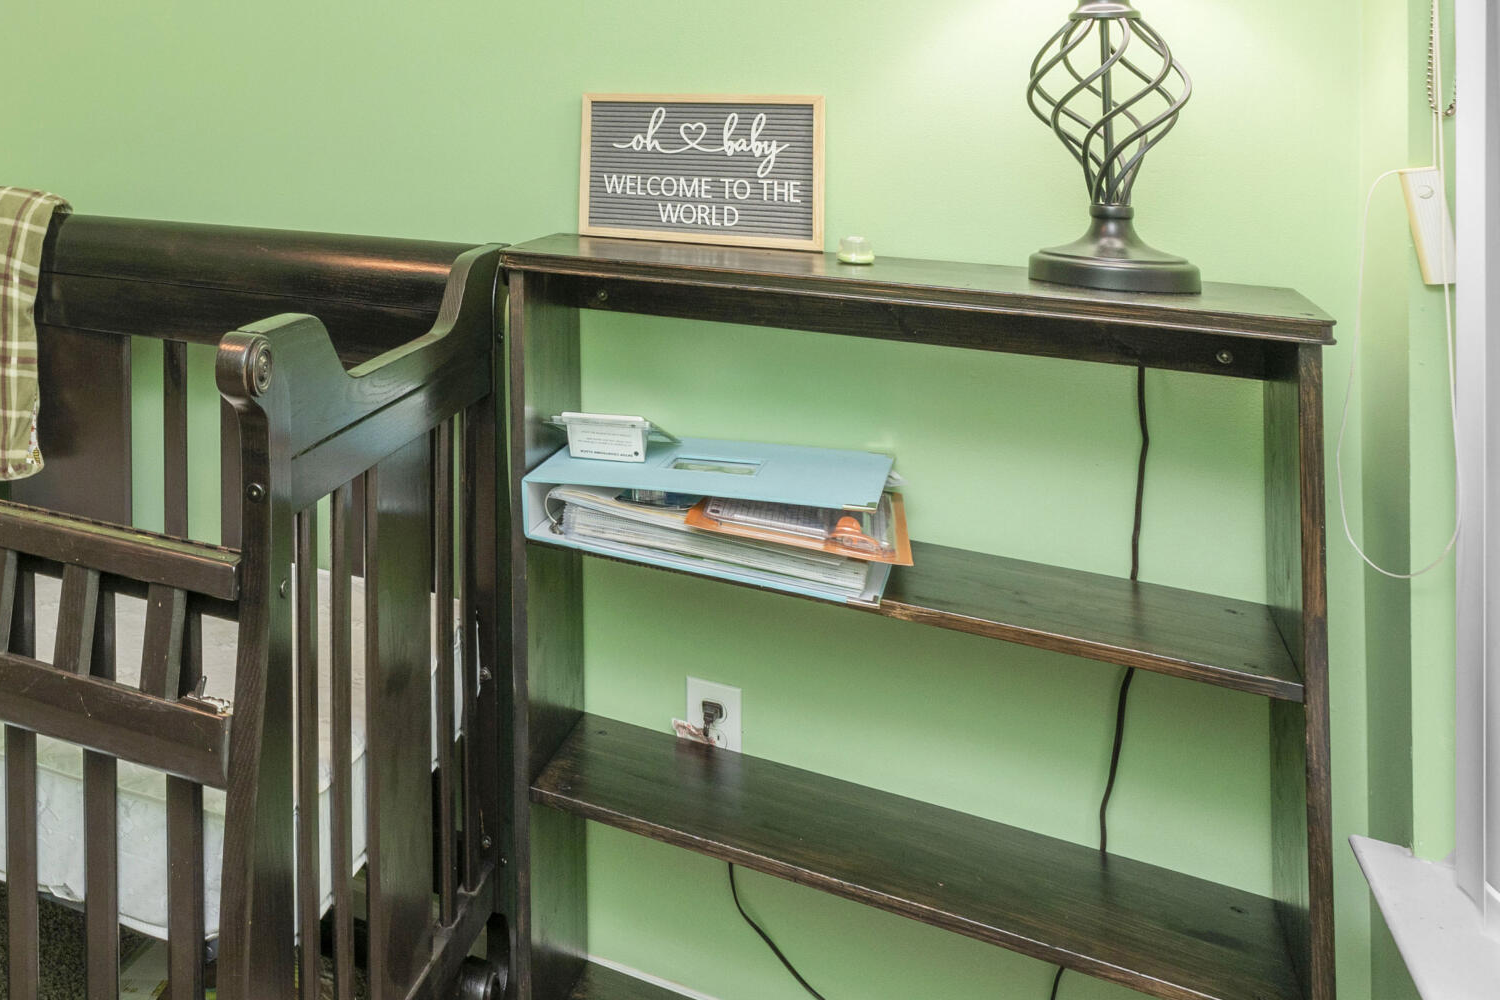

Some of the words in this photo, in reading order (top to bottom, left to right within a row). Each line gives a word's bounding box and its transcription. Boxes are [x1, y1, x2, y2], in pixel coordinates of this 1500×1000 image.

[612, 107, 666, 152] oh
[722, 113, 790, 178] baby
[603, 174, 712, 199] WELCOME
[720, 178, 750, 200] TO
[758, 179, 801, 203] THE
[658, 202, 739, 227] WORLD
